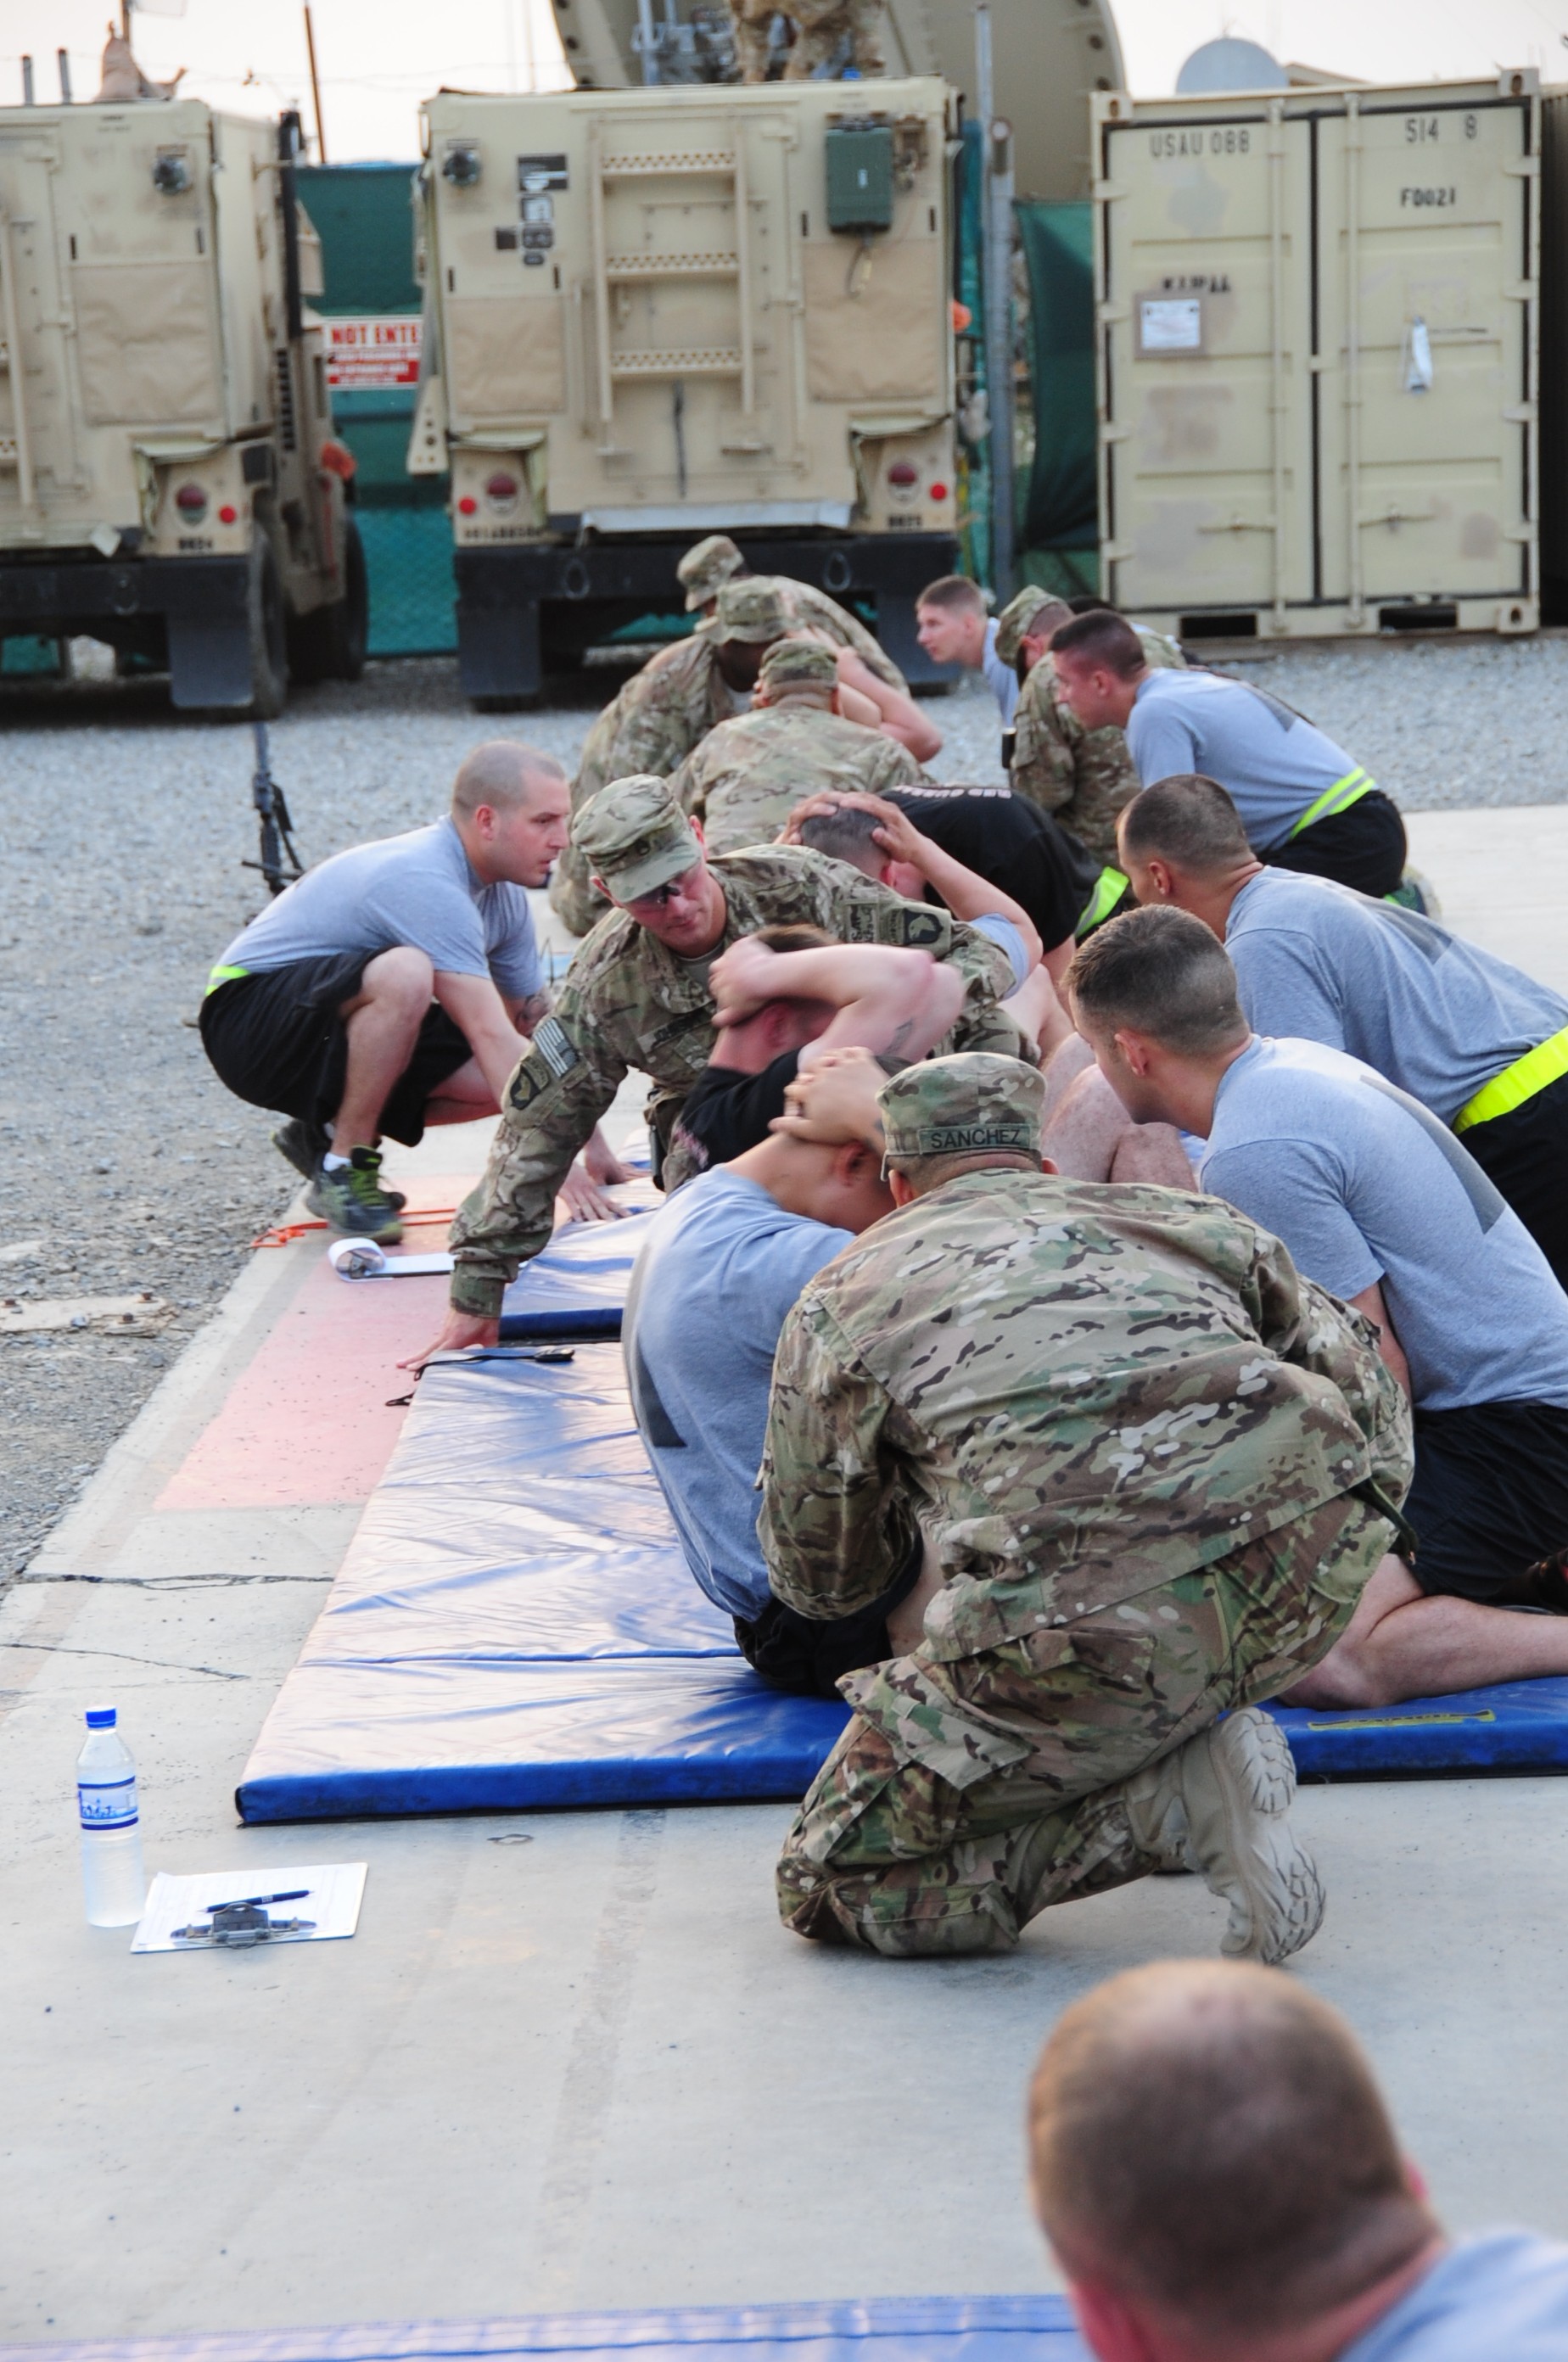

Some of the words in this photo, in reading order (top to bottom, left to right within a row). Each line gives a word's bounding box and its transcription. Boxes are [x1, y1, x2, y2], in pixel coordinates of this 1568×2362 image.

[1405, 117, 1438, 143] 514
[1149, 133, 1205, 158] USAU
[332, 326, 367, 344] NOT
[374, 325, 419, 344] ENTE
[931, 1128, 1022, 1149] SANCHEZ
